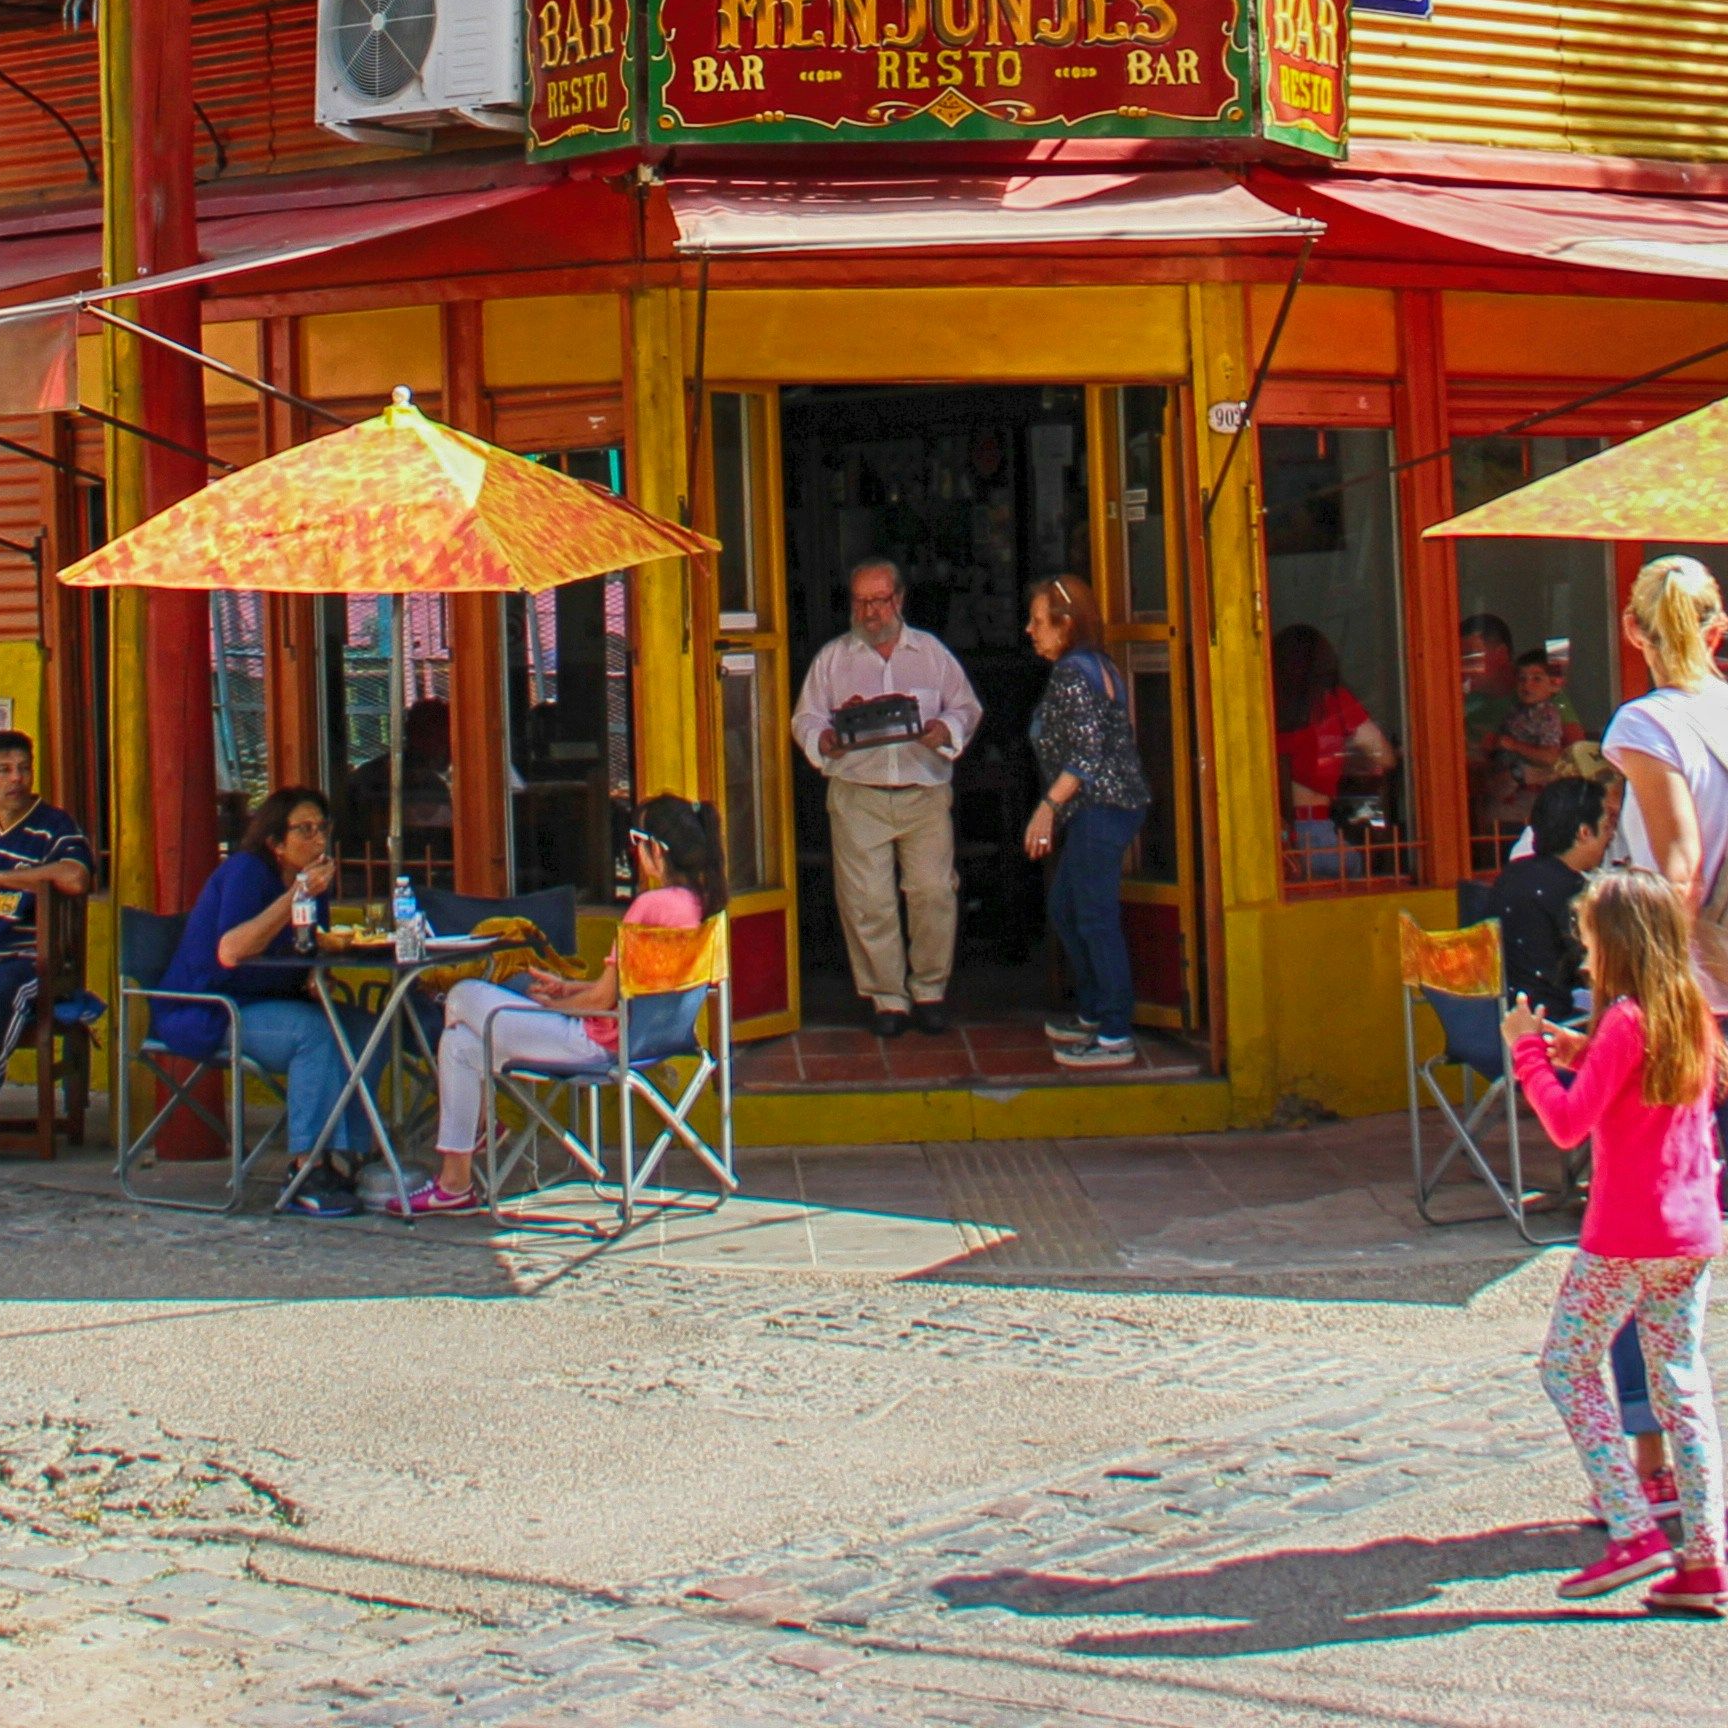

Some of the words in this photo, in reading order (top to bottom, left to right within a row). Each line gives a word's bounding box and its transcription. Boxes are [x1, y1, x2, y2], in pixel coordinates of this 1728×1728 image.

[692, 54, 766, 93] BAR
[877, 50, 1021, 89] RESTO
[1126, 48, 1201, 86] BAR
[1279, 64, 1334, 116] RESTO
[547, 72, 608, 120] RESTO
